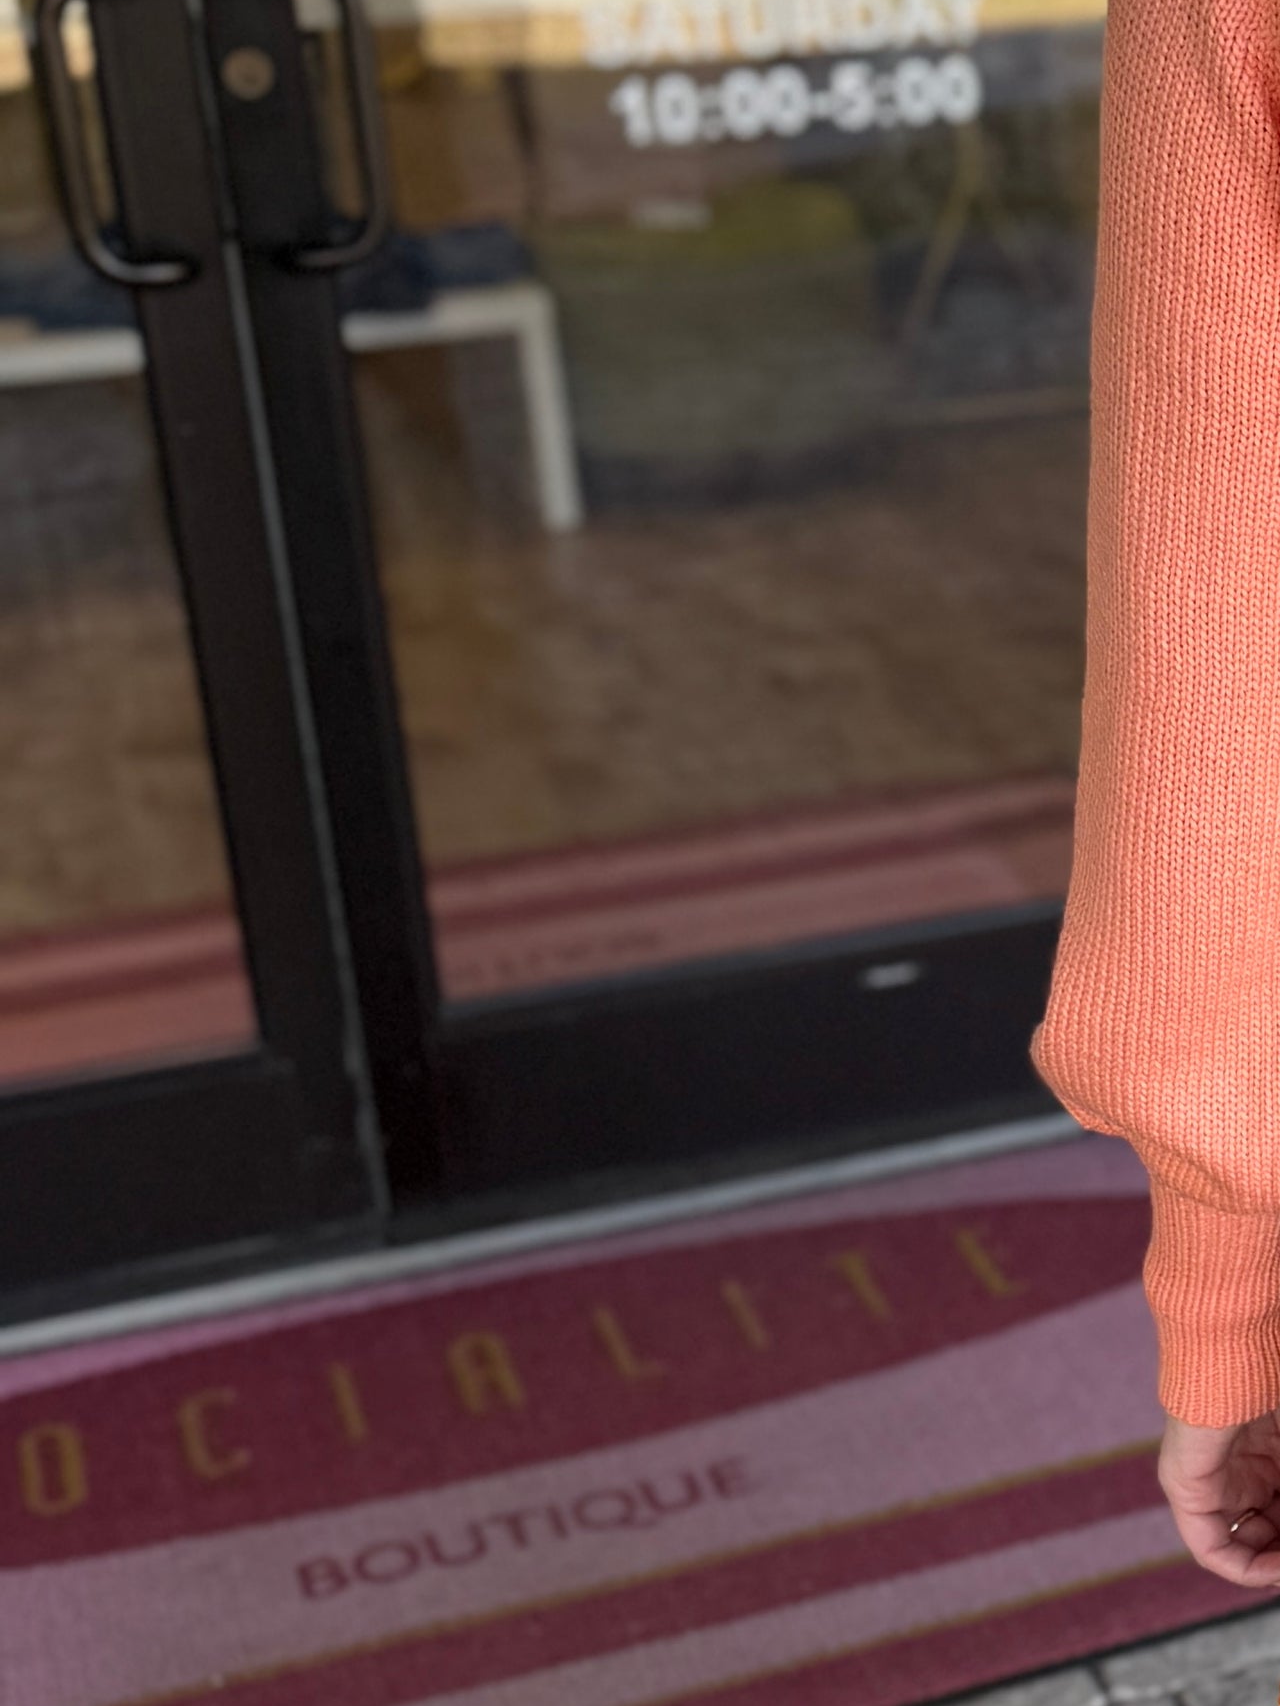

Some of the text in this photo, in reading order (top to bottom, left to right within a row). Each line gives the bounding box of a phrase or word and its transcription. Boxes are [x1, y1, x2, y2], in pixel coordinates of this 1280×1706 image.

[612, 57, 980, 145] 10:00-5:00
[18, 1228, 1024, 1516] OCIALITE
[294, 1455, 758, 1602] BOUTIQUE
